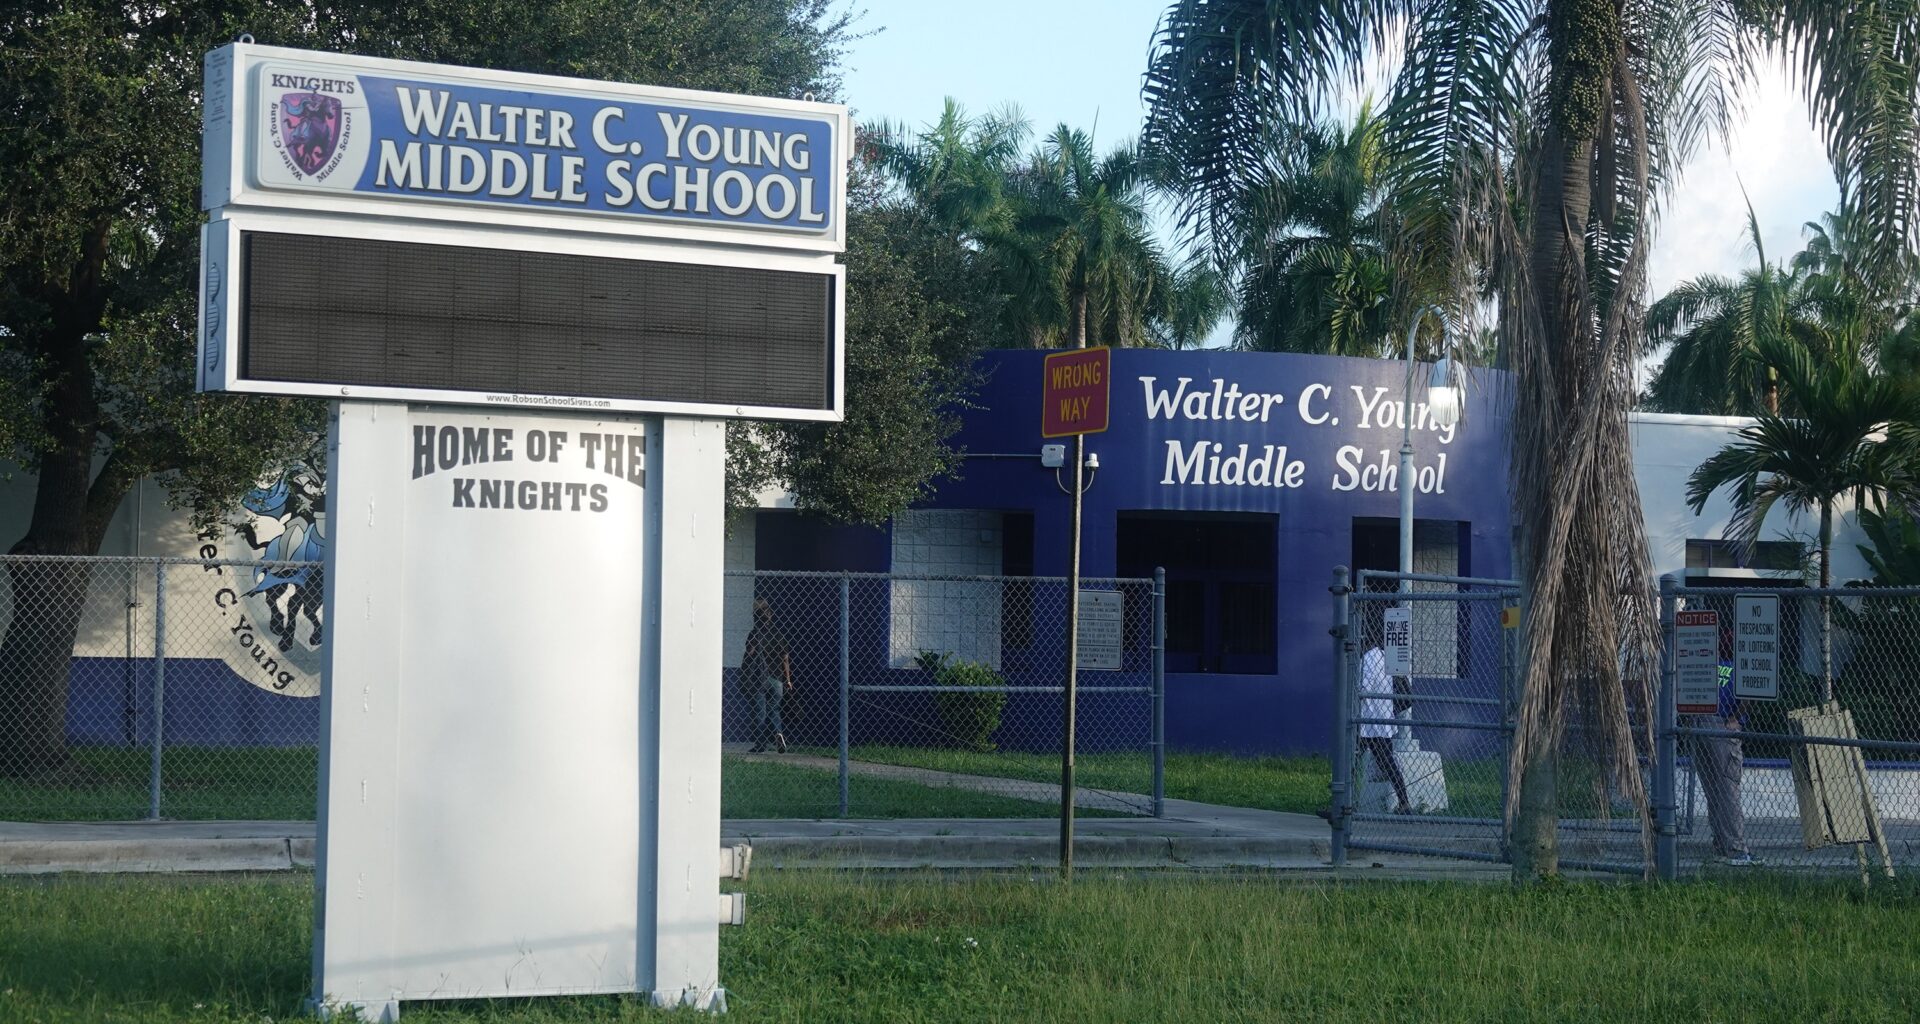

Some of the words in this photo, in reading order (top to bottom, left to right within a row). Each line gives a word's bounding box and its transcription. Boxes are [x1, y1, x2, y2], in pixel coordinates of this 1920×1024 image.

[271, 73, 355, 94] KNIGHTS
[270, 102, 279, 137] Young
[395, 86, 577, 149] WALTER
[591, 106, 642, 156] C.
[657, 111, 810, 171] YOUNG
[273, 137, 282, 148] C.
[316, 152, 343, 183] Middle
[339, 111, 352, 151] School
[280, 149, 303, 181] Walter
[375, 139, 588, 203] MIDDLE
[604, 159, 824, 223] SCHOOL
[1052, 360, 1101, 390] WRONG
[486, 394, 611, 408] www.RobsonSchoolSigns.com
[1060, 396, 1091, 422] WAY
[1138, 376, 1284, 422] Walter
[1298, 383, 1339, 426] C.
[412, 425, 513, 480] HOME
[526, 429, 568, 463] OF
[579, 432, 647, 490] THE
[1160, 440, 1305, 488] Middle
[452, 478, 609, 513] KNIGHTS
[1677, 613, 1716, 625] NOTICE
[1751, 605, 1762, 618] NO
[1386, 620, 1408, 632] SMKE
[1386, 631, 1408, 646] FREE
[1738, 622, 1775, 636] TRESPASSING
[215, 588, 238, 616] C.
[231, 614, 295, 691] Young
[1737, 641, 1746, 653] OR
[1748, 641, 1775, 654] LOITERING
[1740, 658, 1749, 670] ON
[1751, 659, 1773, 671] SCHOOL
[1742, 675, 1770, 689] PROPERTY
